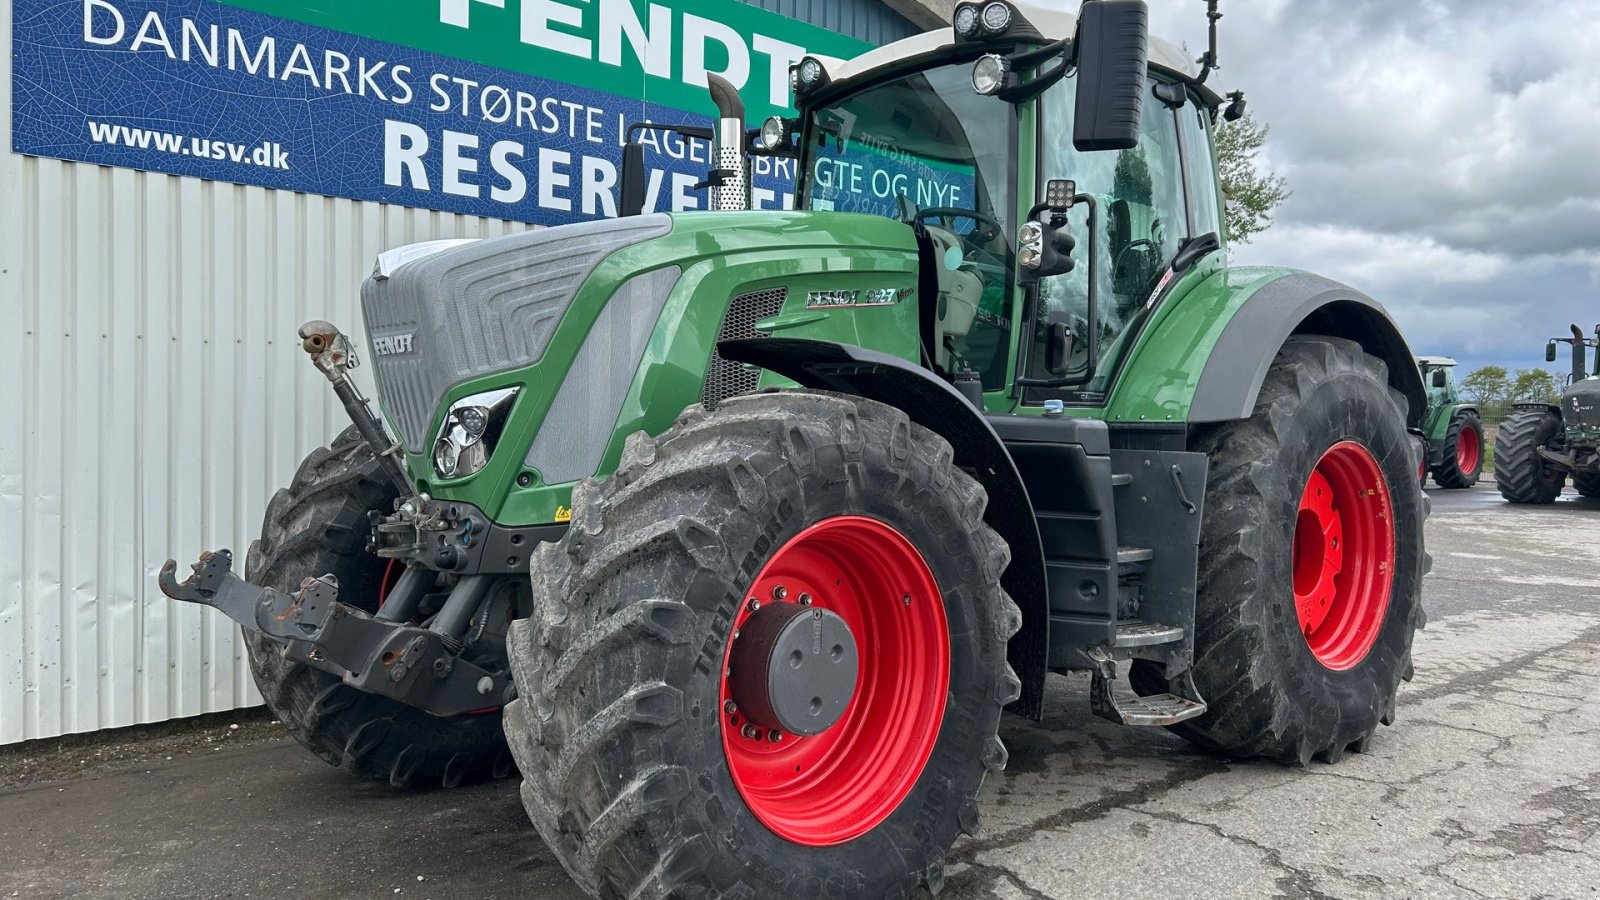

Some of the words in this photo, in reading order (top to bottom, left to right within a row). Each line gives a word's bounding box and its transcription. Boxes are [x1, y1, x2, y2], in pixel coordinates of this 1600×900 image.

[83, 0, 414, 104] DANMARKS
[430, 74, 604, 143] STØRSTE
[619, 113, 713, 165] LAGE
[872, 168, 908, 198] OG
[88, 121, 290, 170] www.usv.dk
[805, 289, 861, 307] FENDT
[866, 287, 896, 304] 927
[372, 333, 415, 356] FENDT
[692, 498, 794, 678] TRELLEBORG
